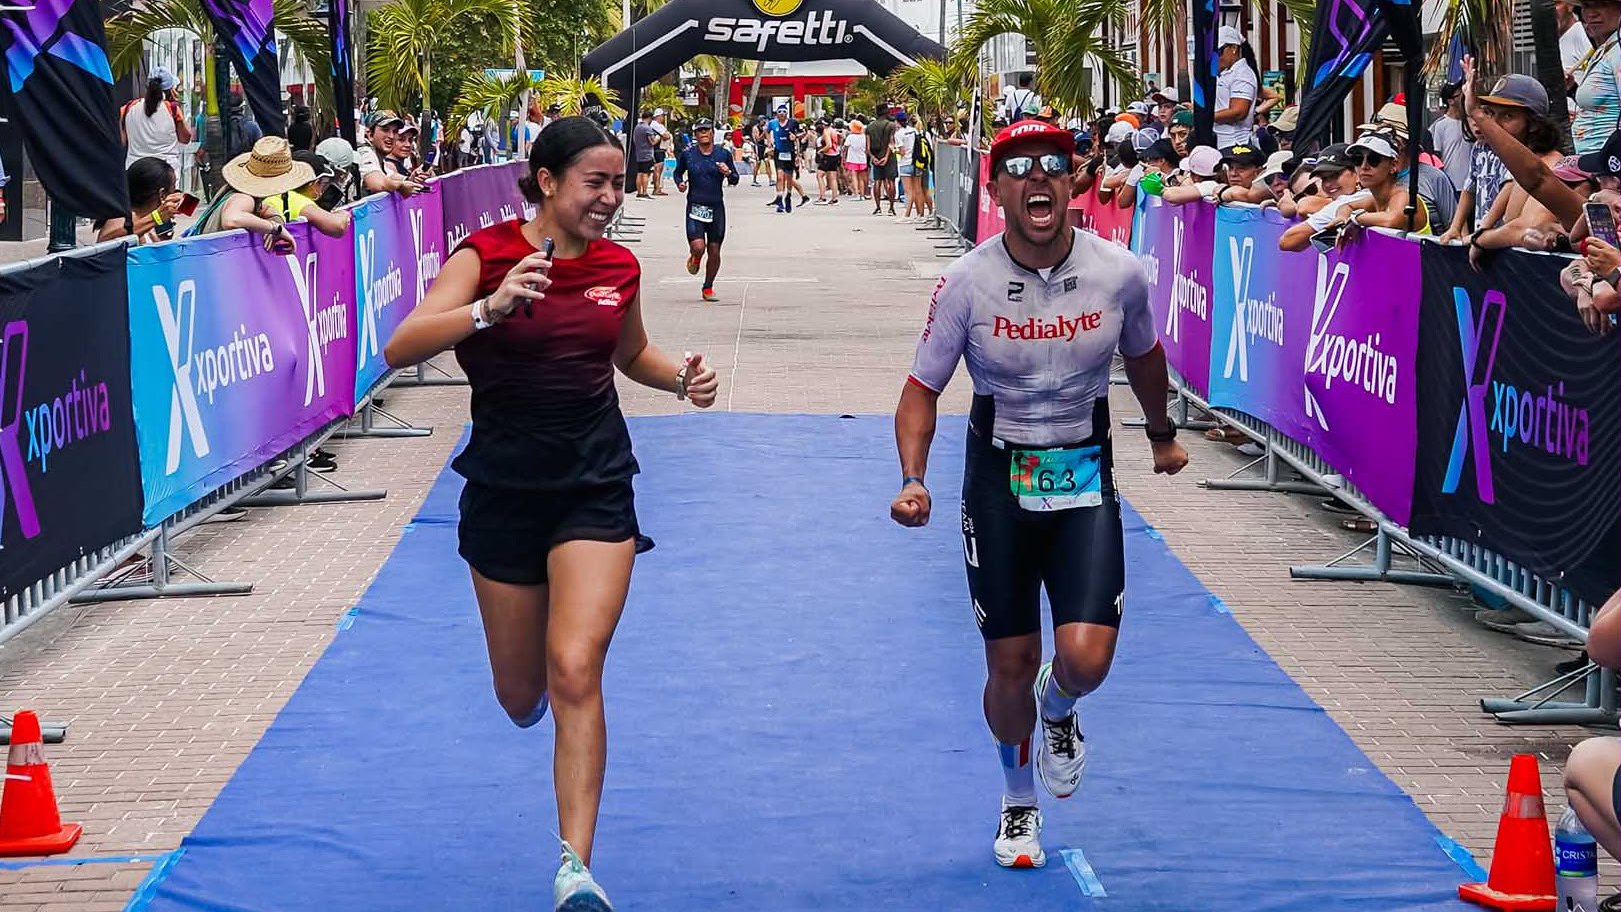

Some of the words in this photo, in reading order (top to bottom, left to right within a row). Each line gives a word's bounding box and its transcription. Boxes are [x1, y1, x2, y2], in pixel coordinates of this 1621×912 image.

[704, 10, 848, 52] safetti
[373, 260, 402, 319] xportiva
[1246, 291, 1284, 346] xportiva
[317, 291, 347, 355] xportiva
[992, 312, 1101, 342] Pedialyte
[194, 324, 274, 405] xportiva
[1307, 332, 1398, 404] xportiva
[25, 368, 110, 473] xportiva
[1491, 381, 1589, 466] xportiva
[1038, 469, 1077, 493] 63
